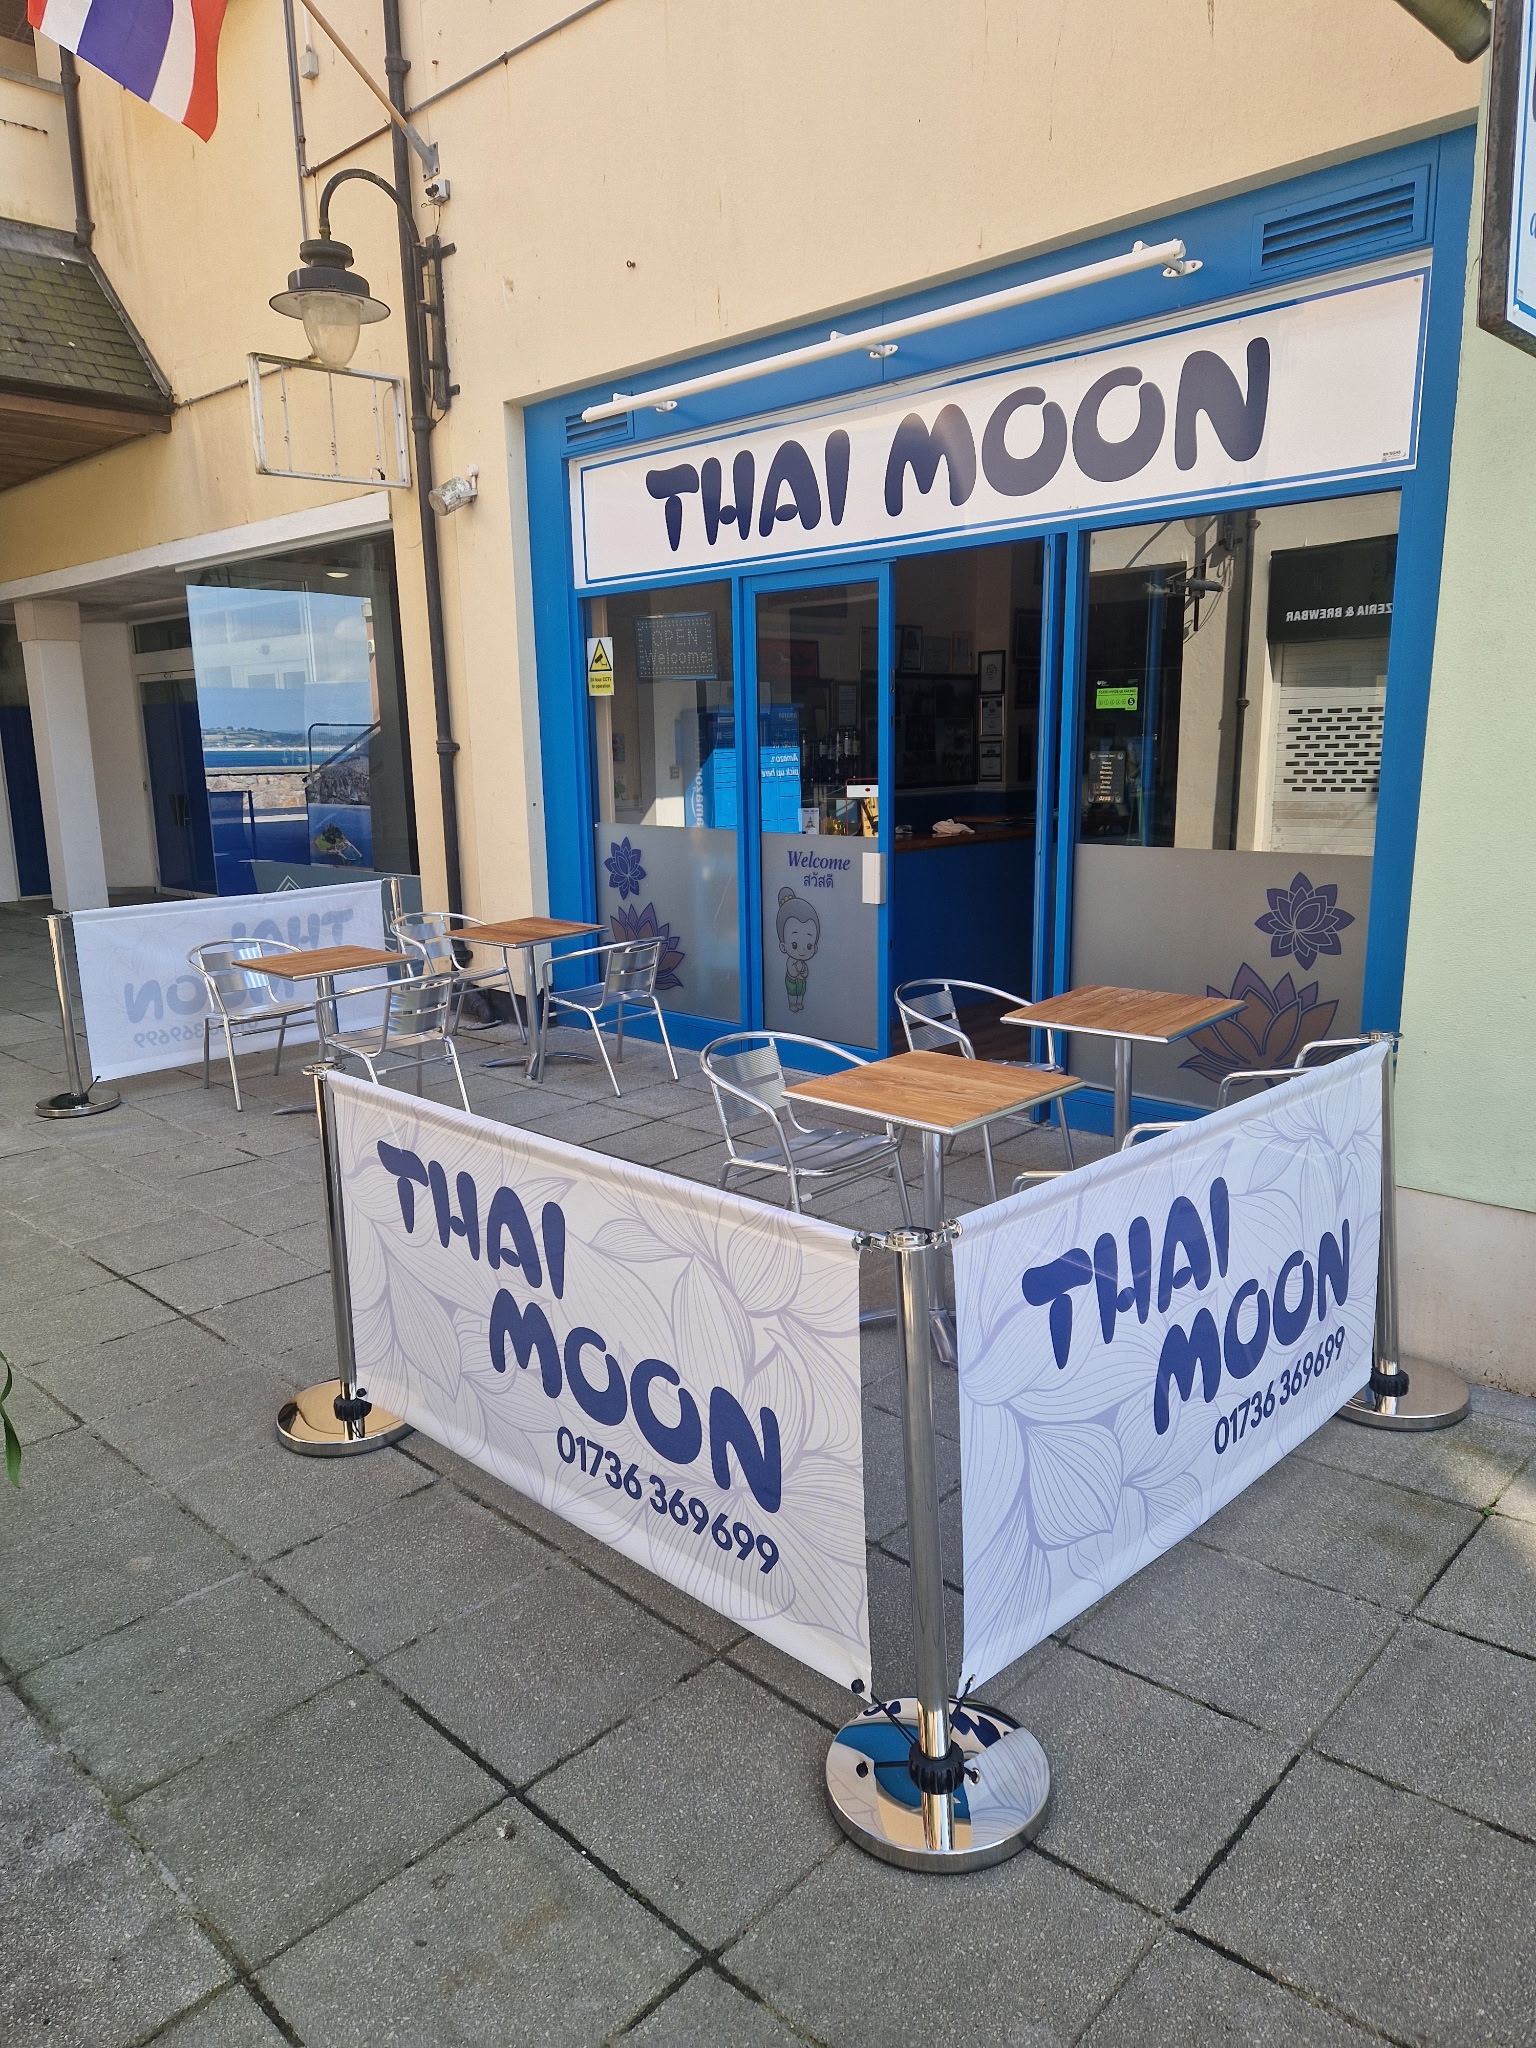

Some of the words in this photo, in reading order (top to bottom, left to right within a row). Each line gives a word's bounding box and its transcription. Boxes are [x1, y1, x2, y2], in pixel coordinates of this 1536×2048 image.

[645, 429, 851, 552] THAI
[884, 337, 1271, 518] MOON
[644, 649, 708, 666] Welcome
[652, 628, 698, 647] OPEN
[787, 850, 851, 871] Welcome
[803, 872, 834, 888] สวัสดี
[376, 1140, 566, 1299] THAI
[1022, 1177, 1230, 1370] THAI
[489, 1288, 782, 1513] MOON
[1153, 1218, 1350, 1435] MOON
[1214, 1381, 1275, 1455] 01736
[1280, 1326, 1345, 1406] 369699
[557, 1426, 643, 1500] 01736
[649, 1475, 779, 1574] 369699
